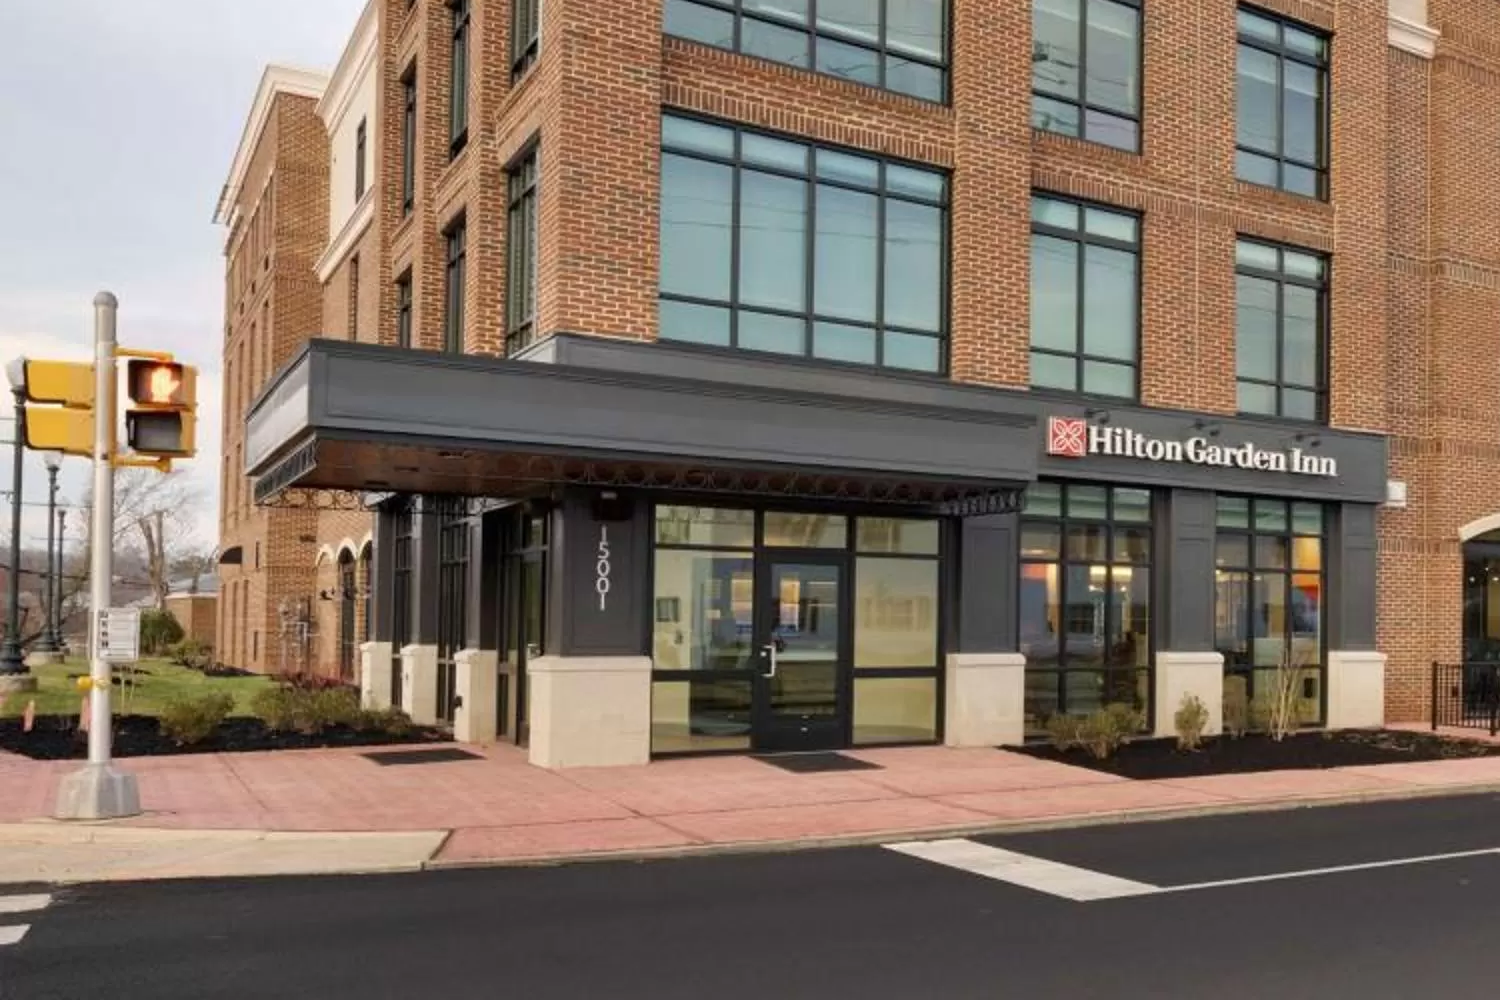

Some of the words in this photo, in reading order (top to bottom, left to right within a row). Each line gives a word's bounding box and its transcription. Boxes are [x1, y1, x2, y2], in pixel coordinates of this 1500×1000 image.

[1088, 424, 1183, 462] Hilton
[1185, 436, 1286, 472] Garden
[1291, 447, 1338, 477] Inn
[596, 524, 611, 611] 15001
